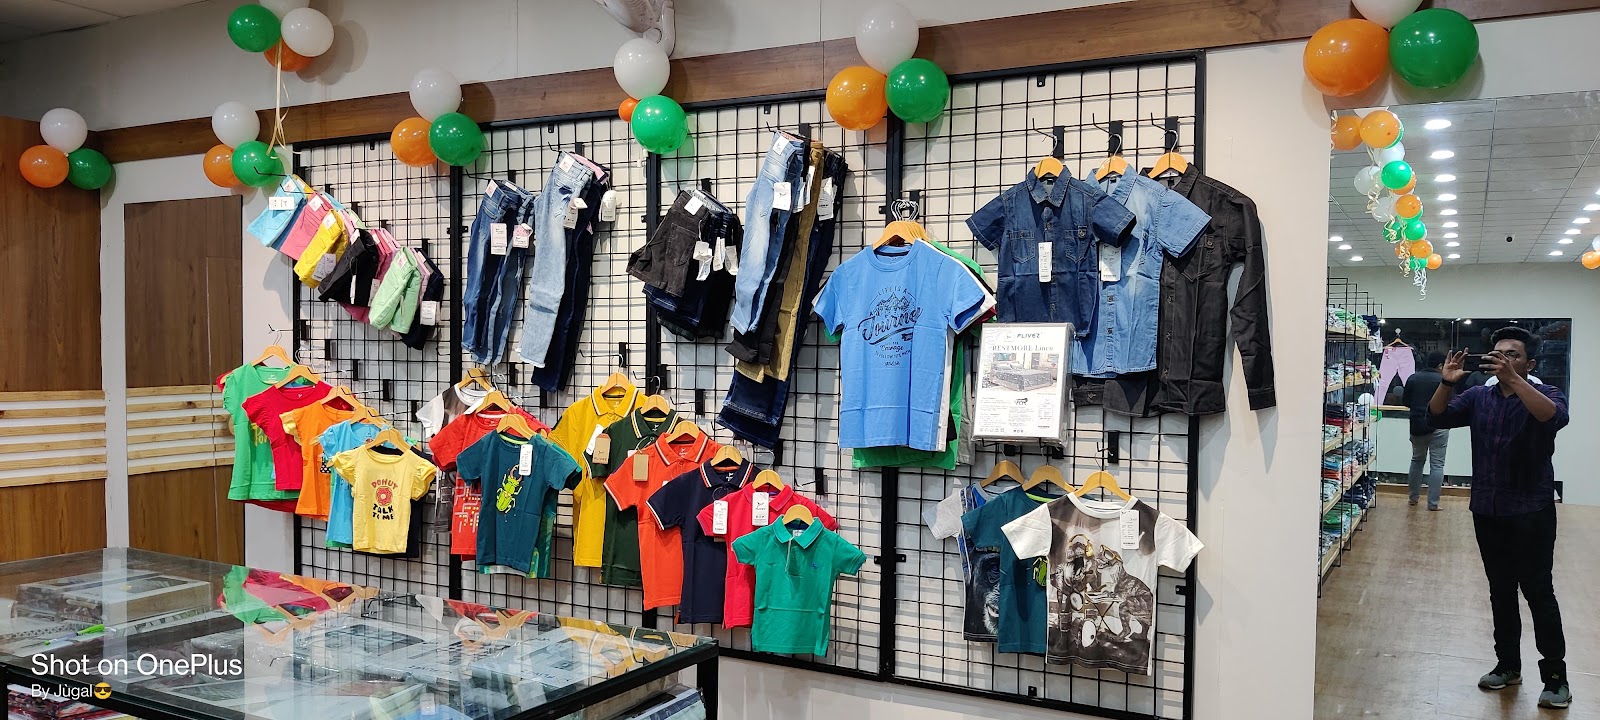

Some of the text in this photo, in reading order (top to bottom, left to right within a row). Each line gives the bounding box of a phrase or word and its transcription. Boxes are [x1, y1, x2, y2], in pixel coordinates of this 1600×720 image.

[371, 478, 398, 489] DONUT
[372, 503, 394, 515] TALK
[382, 513, 394, 521] ME
